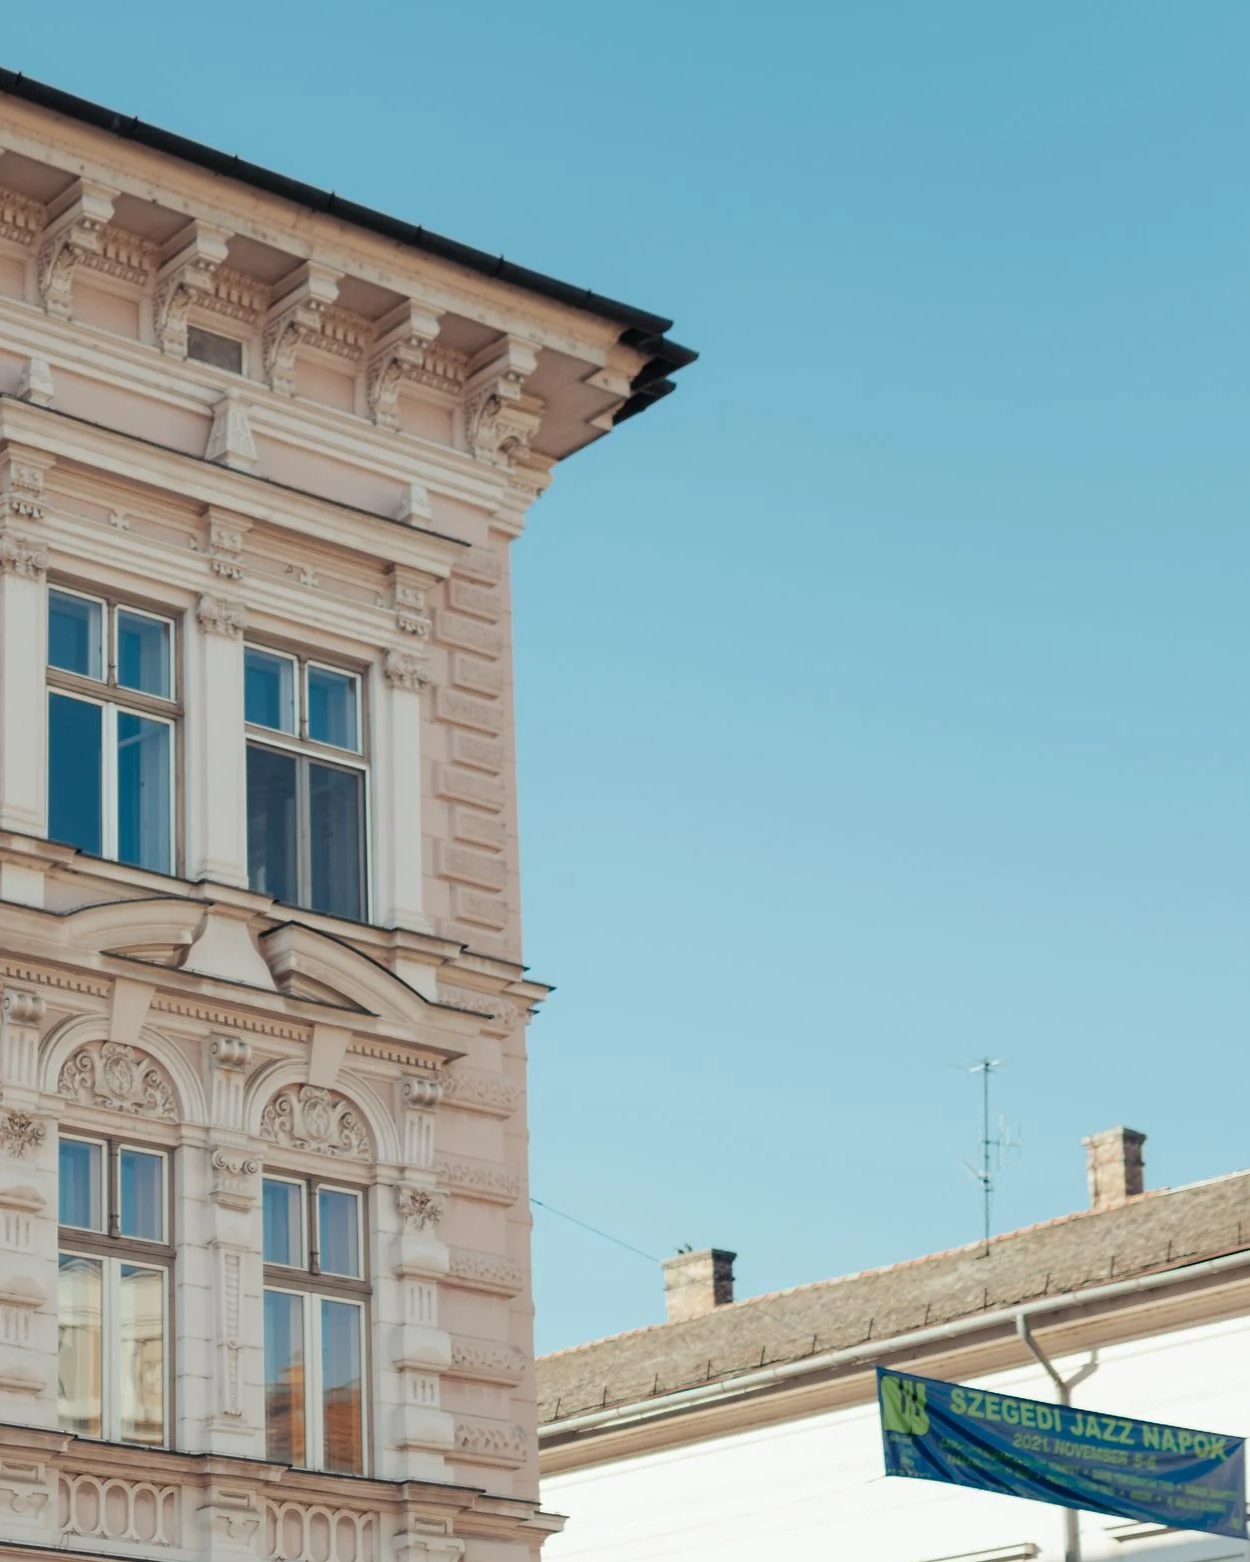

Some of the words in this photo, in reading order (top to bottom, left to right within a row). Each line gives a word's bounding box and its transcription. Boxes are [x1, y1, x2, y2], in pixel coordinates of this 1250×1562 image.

[950, 1388, 1062, 1433] SZEGEDI
[1070, 1411, 1135, 1446] JAZZ
[1141, 1424, 1228, 1461] NAPOK
[1053, 1439, 1127, 1466] NOVEMBER
